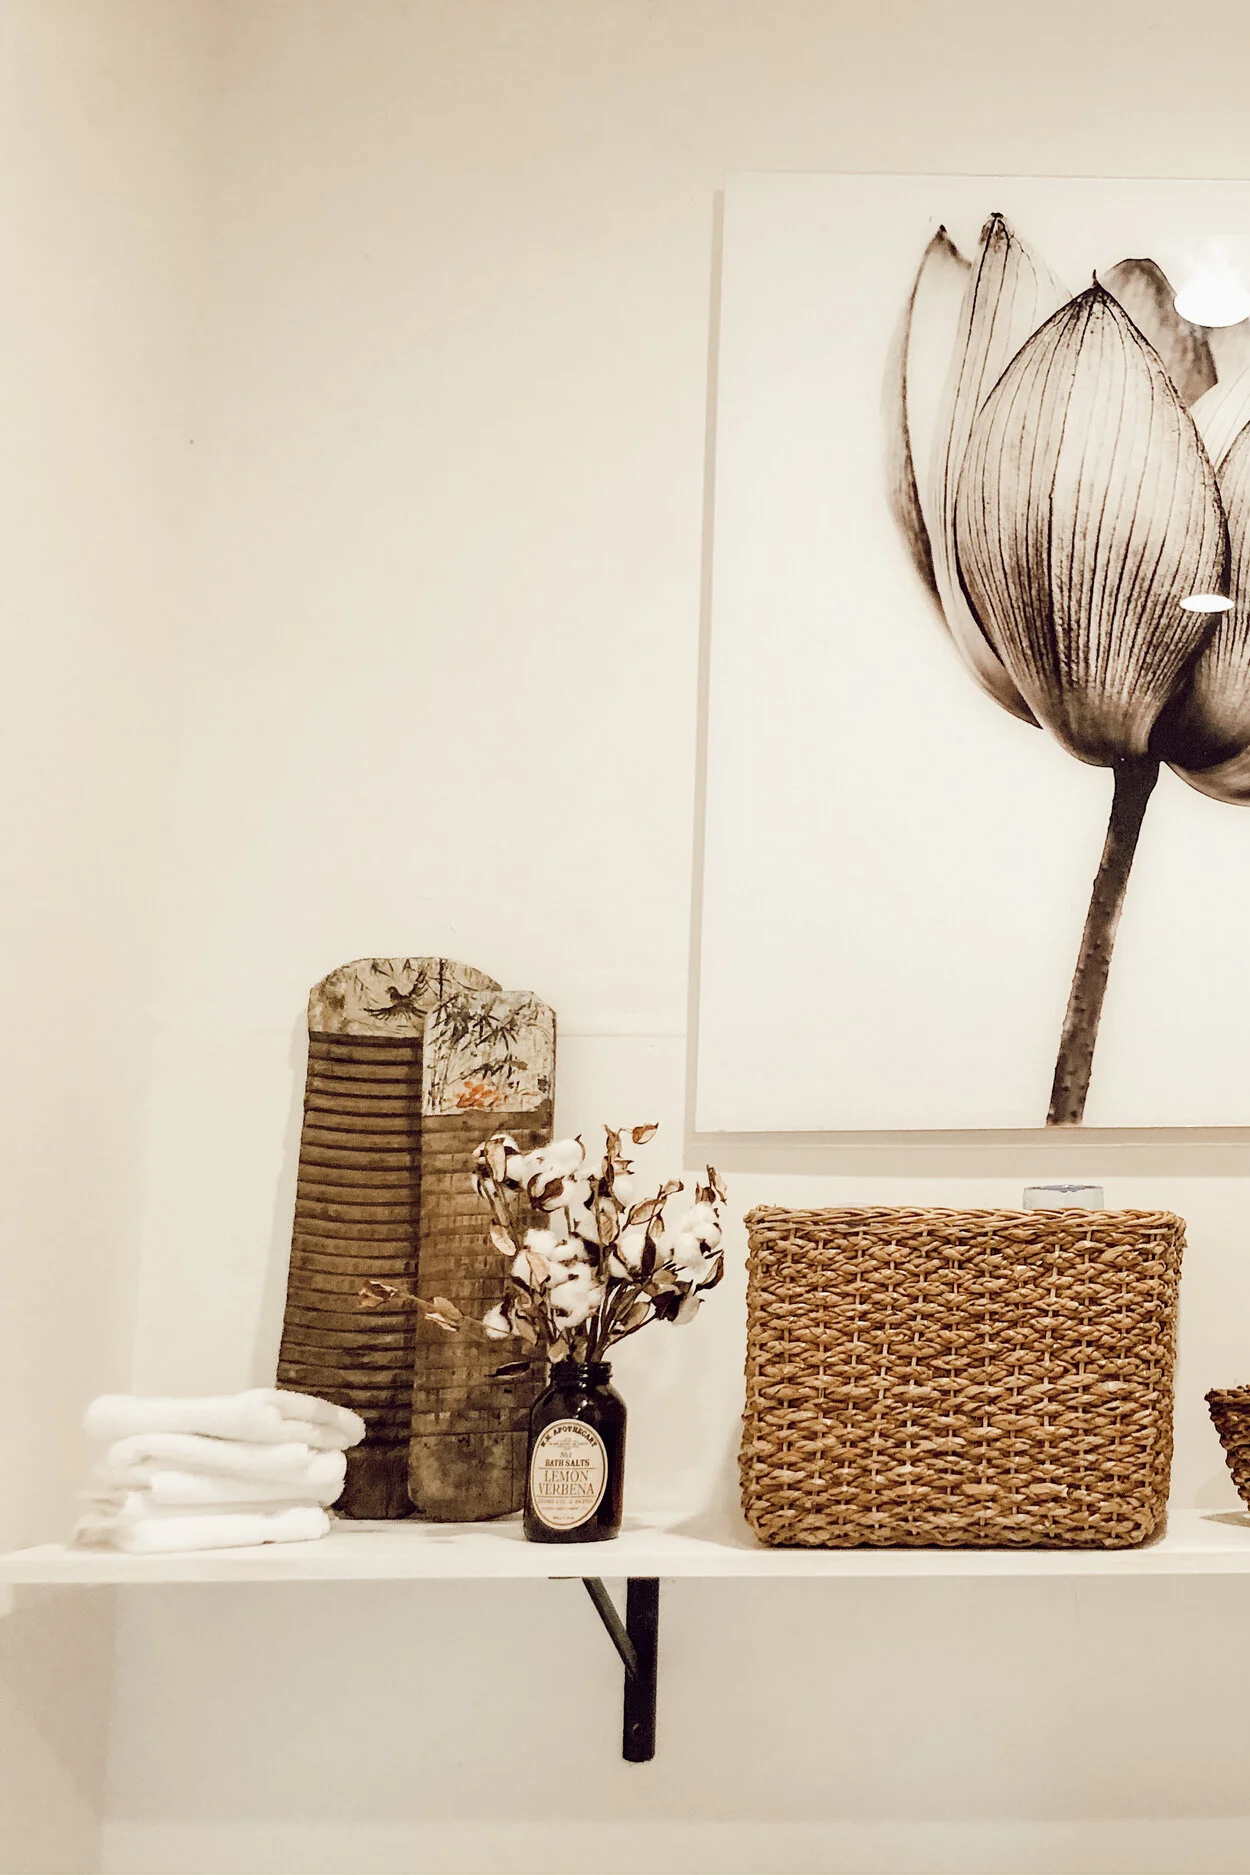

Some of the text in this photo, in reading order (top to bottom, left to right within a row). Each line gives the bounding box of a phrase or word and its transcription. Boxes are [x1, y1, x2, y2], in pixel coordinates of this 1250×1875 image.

[553, 1425, 598, 1448] APOTHECARY
[545, 1459, 590, 1467] BATH SALTS
[545, 1470, 589, 1482] LEMON
[539, 1482, 595, 1496] VERBENA
